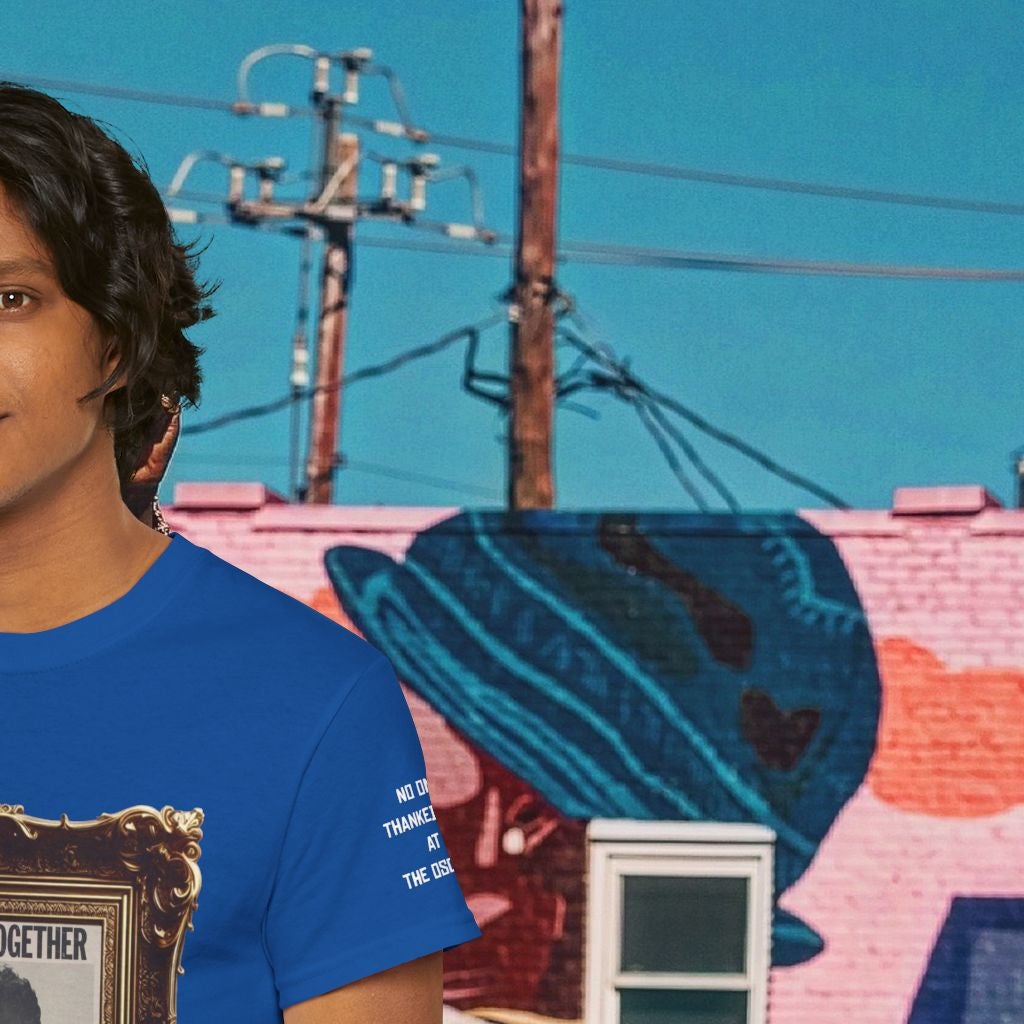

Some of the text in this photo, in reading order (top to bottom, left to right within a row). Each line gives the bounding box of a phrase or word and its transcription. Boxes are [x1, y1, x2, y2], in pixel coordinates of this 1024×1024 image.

[396, 783, 415, 804] NO
[426, 832, 441, 852] AT
[402, 866, 431, 890] THE
